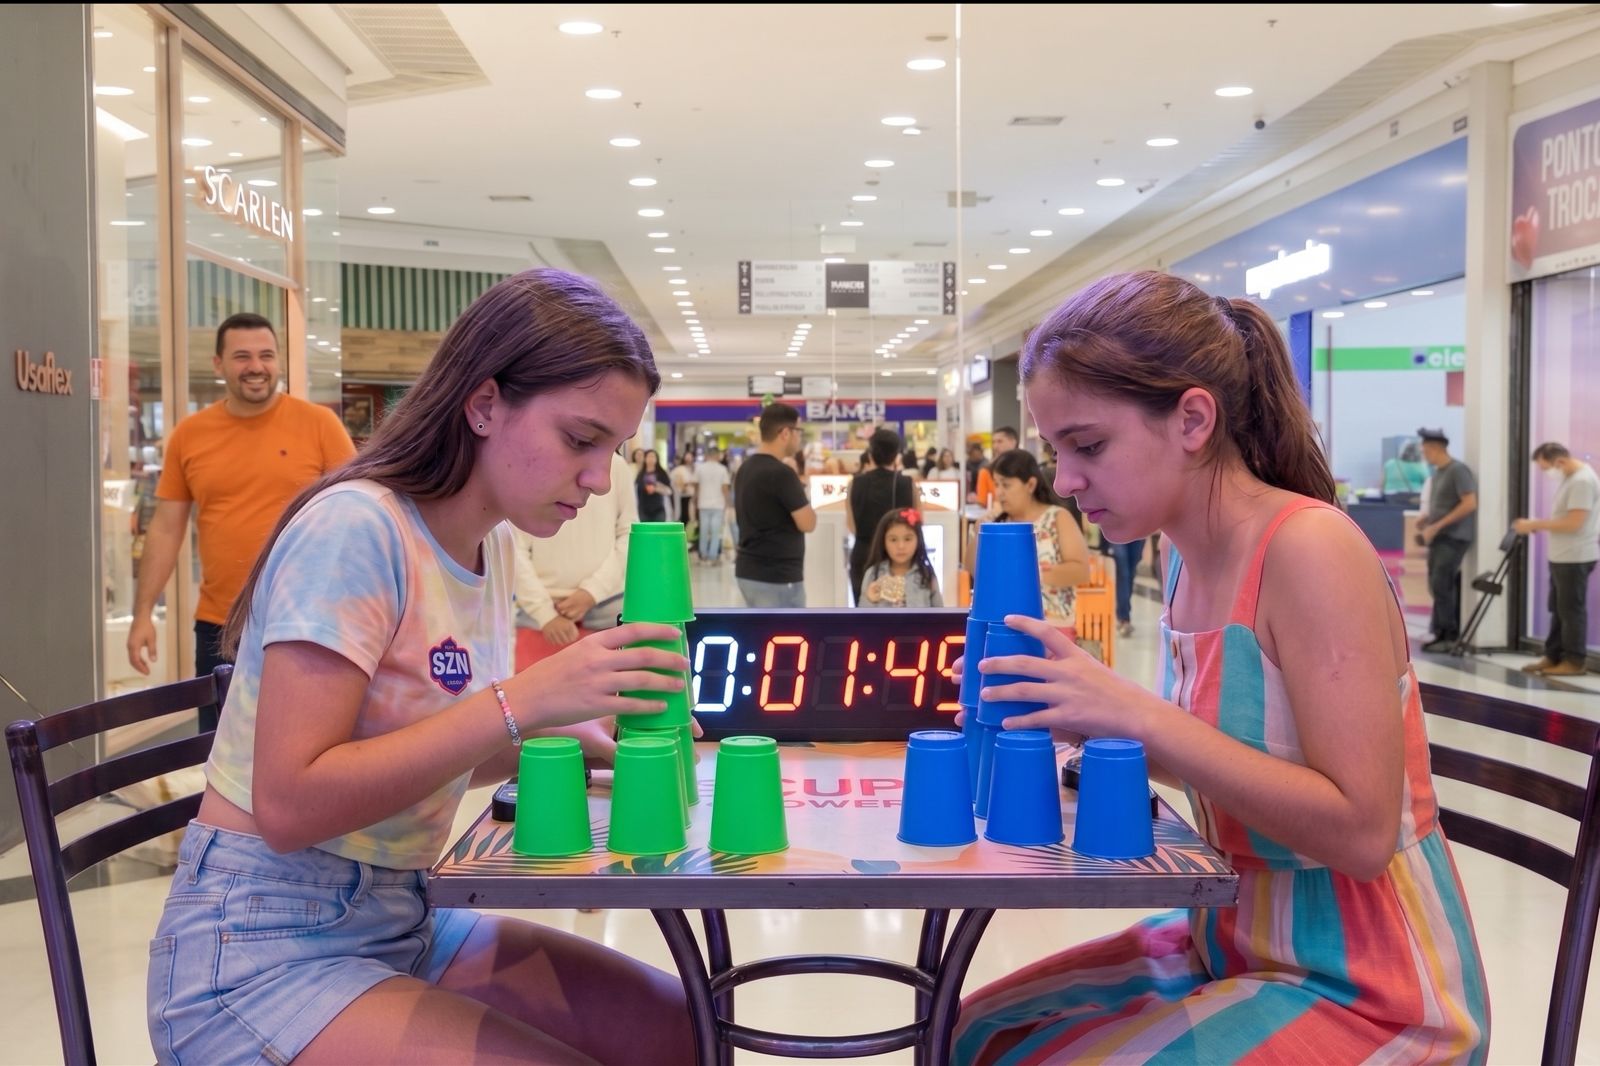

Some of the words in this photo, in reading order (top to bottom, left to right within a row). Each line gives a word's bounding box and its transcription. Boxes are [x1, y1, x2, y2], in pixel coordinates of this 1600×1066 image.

[205, 165, 293, 242] SCARLEN
[1547, 174, 1600, 231] TROC
[15, 349, 73, 396] Usaflex
[432, 651, 470, 676] SZN
